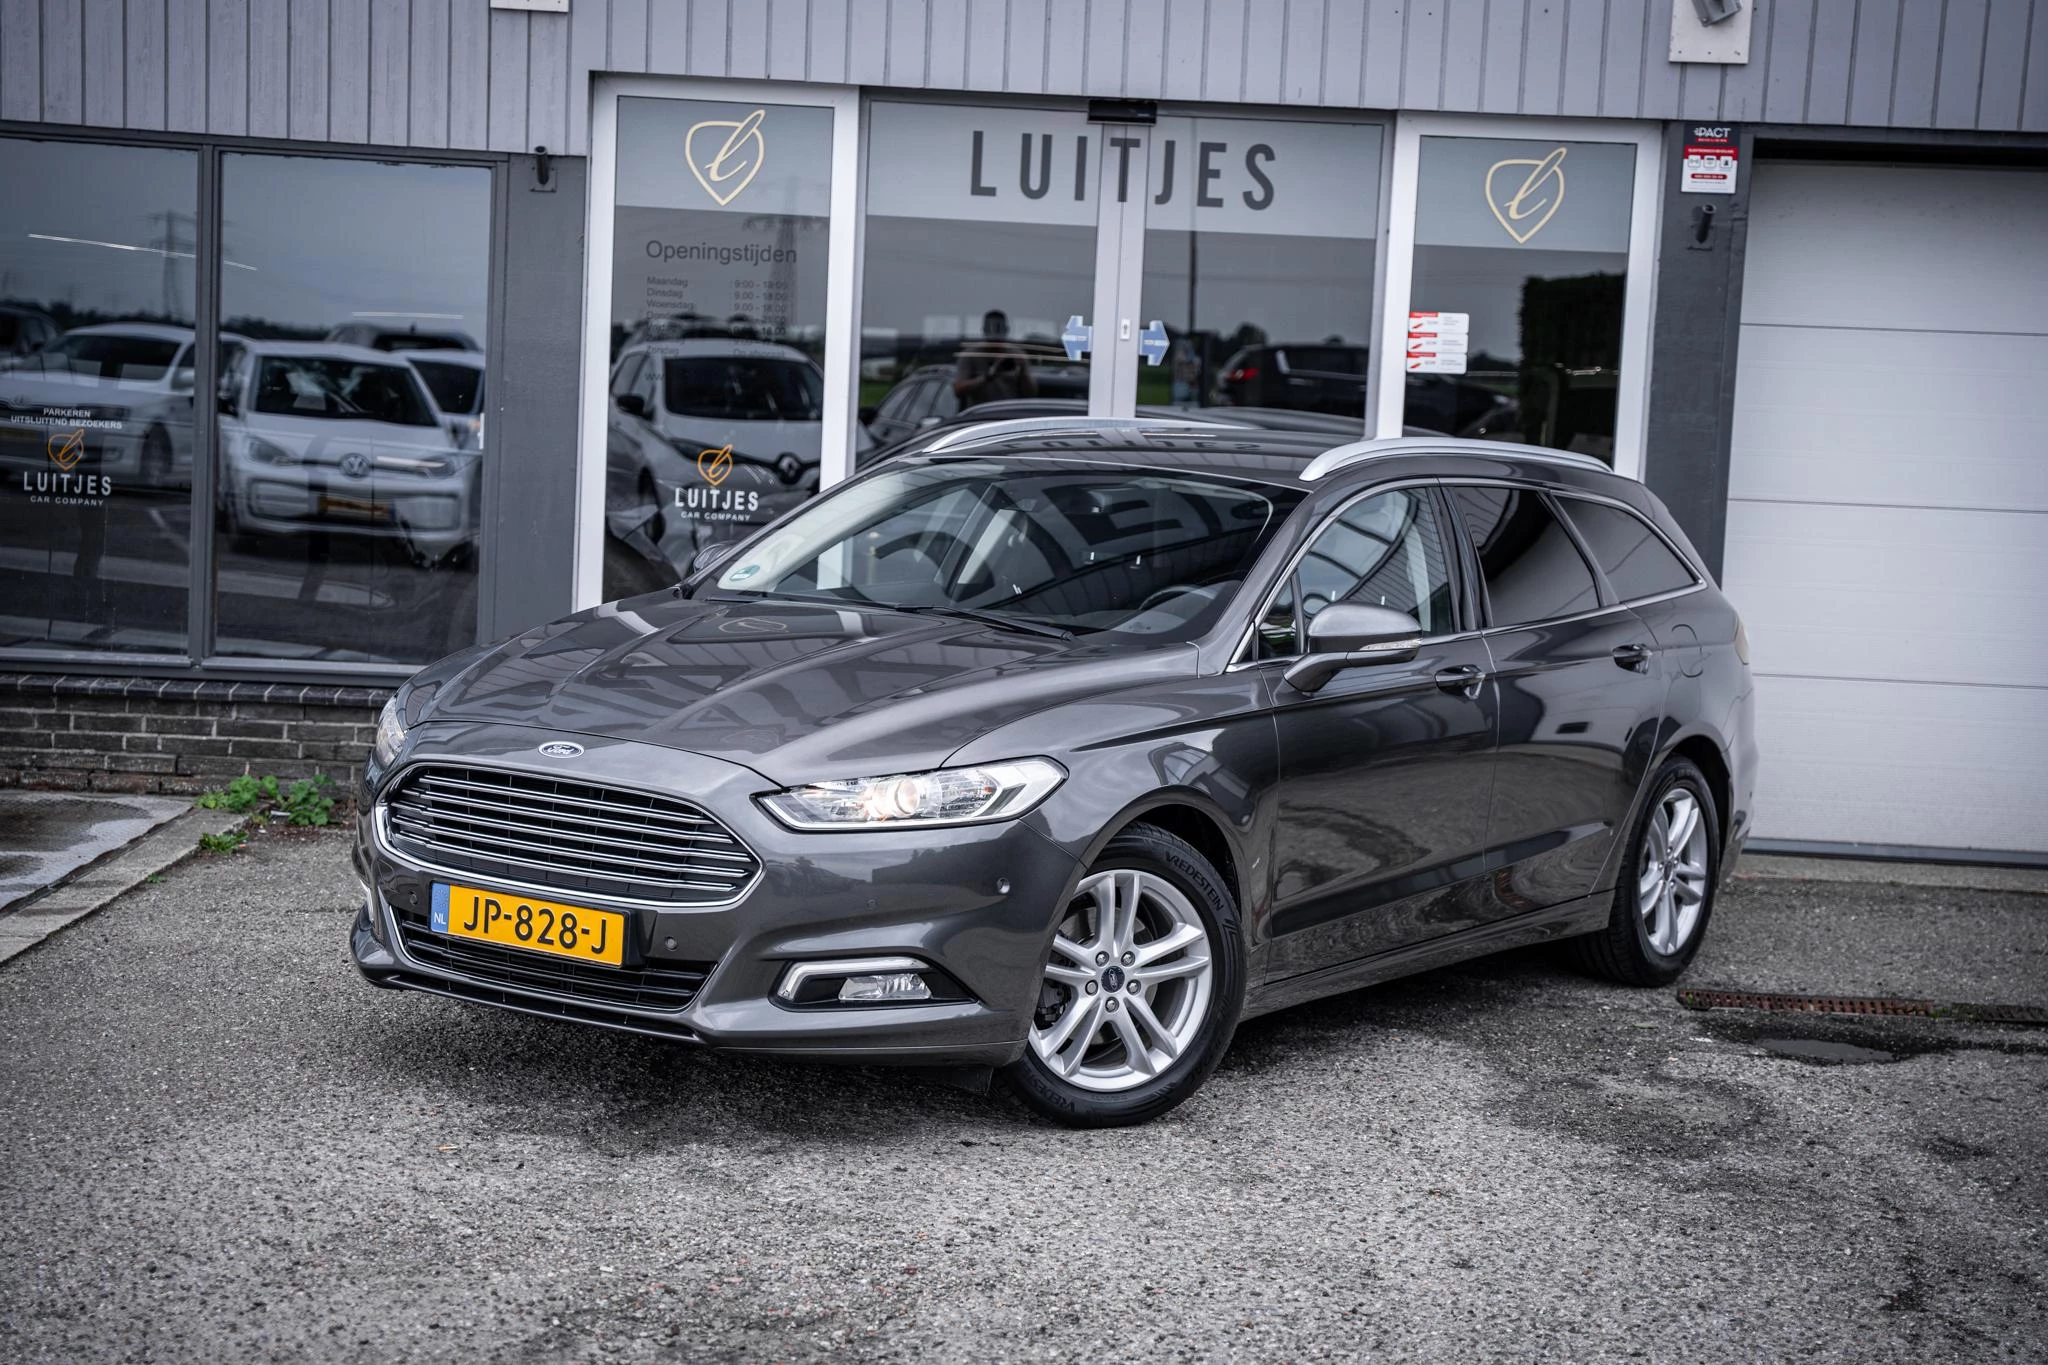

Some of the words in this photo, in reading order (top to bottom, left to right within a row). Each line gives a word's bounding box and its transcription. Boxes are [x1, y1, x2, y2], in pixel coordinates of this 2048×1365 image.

[970, 130, 1276, 211] LUITJES
[645, 239, 797, 267] Openingstijden
[646, 276, 688, 288] Maandag
[646, 287, 683, 299] Dinsdag
[646, 298, 695, 310] Woensdag
[43, 408, 91, 418] PARKEREN
[11, 415, 68, 426] UITSLUITEND
[69, 418, 123, 429] BEZOEKERS
[23, 471, 112, 496] LUITJES
[30, 495, 50, 503] CAR
[55, 496, 104, 507] COMPANY
[675, 487, 759, 512] LUITJES
[680, 511, 700, 519] CAR
[704, 512, 751, 522] COMPANY
[545, 743, 576, 756] Ford
[1165, 851, 1224, 912] VREDESTEIN
[433, 912, 446, 925] NL
[464, 896, 607, 954] JP-828-J
